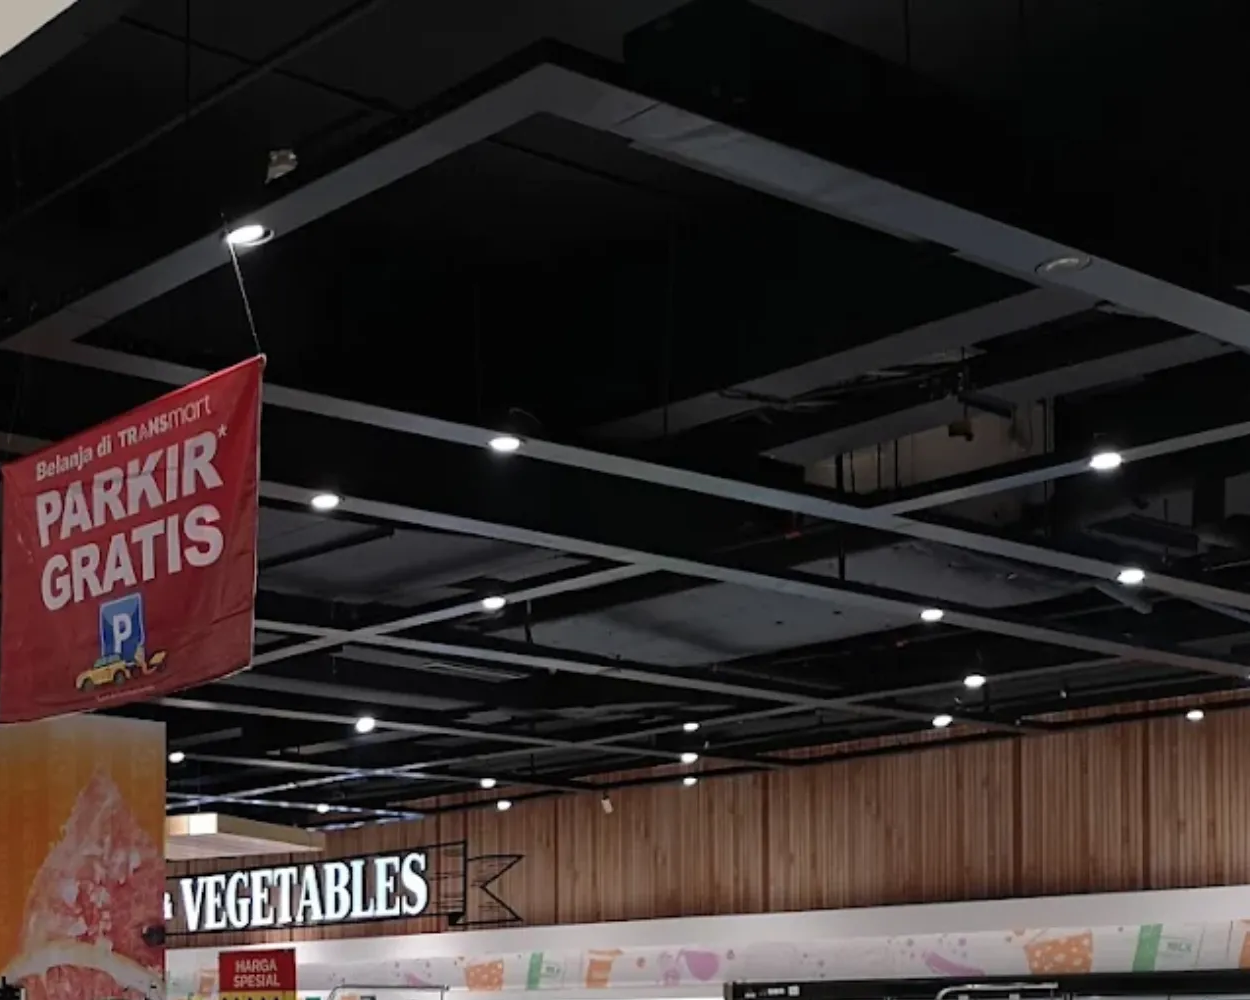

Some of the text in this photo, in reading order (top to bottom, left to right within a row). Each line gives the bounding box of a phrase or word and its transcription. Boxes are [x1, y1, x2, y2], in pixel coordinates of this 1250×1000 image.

[36, 448, 93, 481] Belanja
[96, 436, 112, 459] di
[41, 504, 224, 611] GRATIS
[180, 852, 428, 931] VEGETABLES
[233, 973, 281, 988] SPESIAL
[235, 958, 277, 973] HARGA
